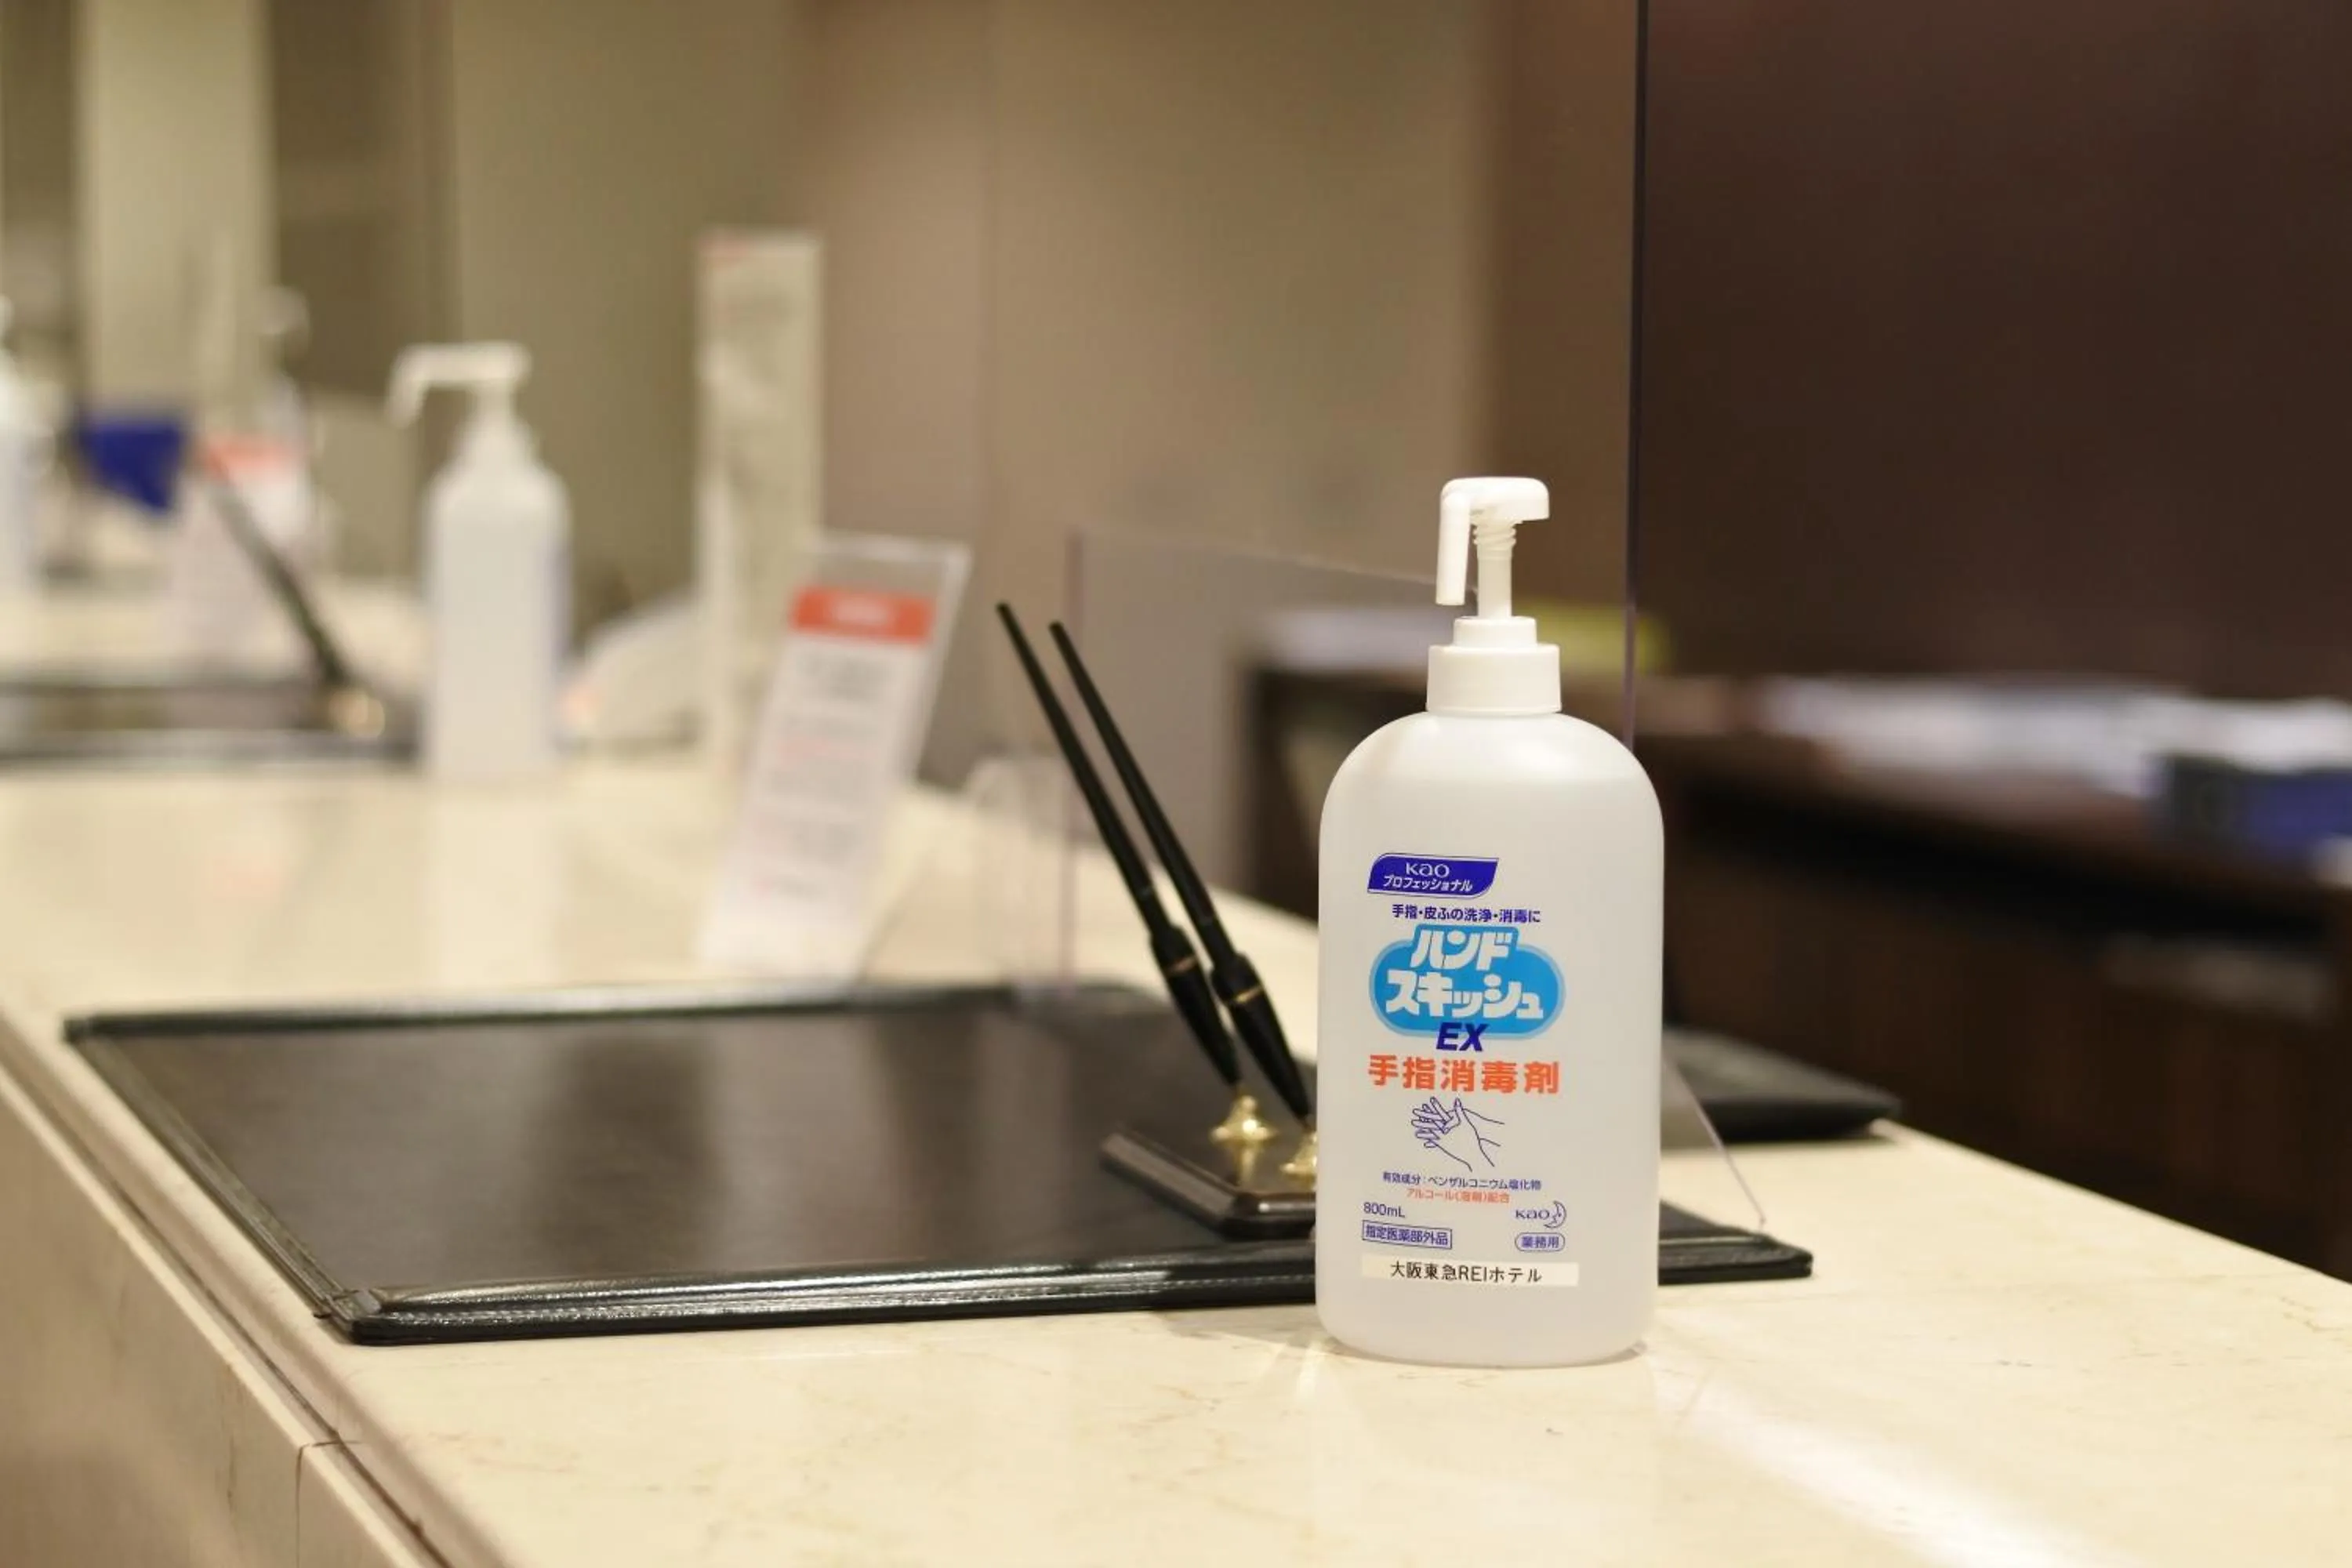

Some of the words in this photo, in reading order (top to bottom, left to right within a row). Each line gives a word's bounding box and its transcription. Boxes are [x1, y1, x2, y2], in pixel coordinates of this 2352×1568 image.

[1406, 862, 1450, 878] kao
[1383, 874, 1473, 891] プロフェッショナル
[1392, 904, 1541, 923] 手指・皮ふの洗浄・消毒に
[1410, 930, 1513, 971] ハンド
[1385, 969, 1544, 1019] スキッシュ
[1436, 1022, 1488, 1051] EX
[1368, 1054, 1560, 1094] 手指消毒剤
[1363, 1202, 1405, 1218] 800mL
[1367, 1224, 1448, 1246] 指定医薬部外品
[1390, 1261, 1542, 1283] 大阪東急REIホテル
